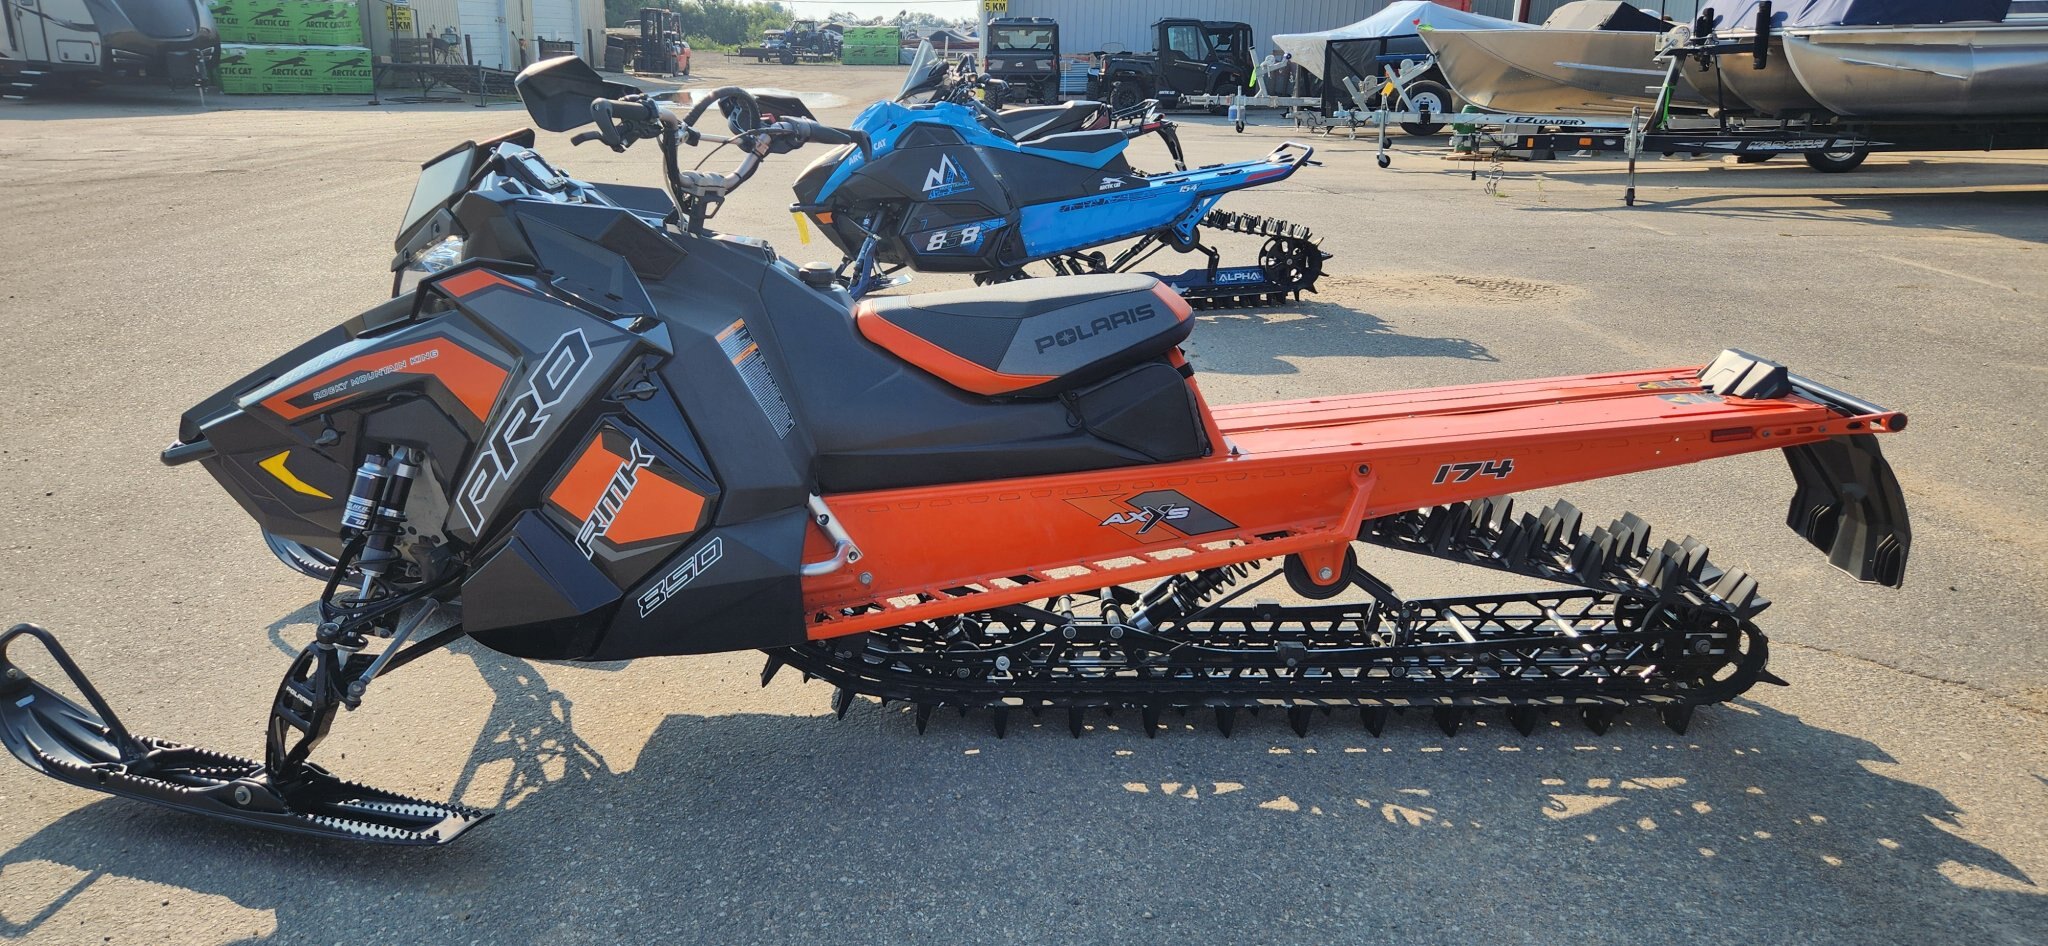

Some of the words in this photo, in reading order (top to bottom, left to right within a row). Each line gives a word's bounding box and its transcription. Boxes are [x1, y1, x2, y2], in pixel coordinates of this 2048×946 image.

[985, 2, 990, 10] 5
[992, 2, 1005, 11] KM
[848, 151, 863, 166] ARC
[873, 138, 887, 151] CAT
[1179, 184, 1197, 193] 154
[926, 226, 981, 252] 858
[1219, 272, 1259, 282] ALPHA
[1034, 303, 1156, 355] POLARIS
[313, 380, 349, 401] ROCKY
[350, 360, 407, 387] MOUNTAIN
[409, 349, 439, 366] KING
[456, 327, 594, 538] PRO
[1432, 458, 1515, 485] 174
[574, 437, 655, 560] RMK
[637, 536, 723, 619] 850
[286, 685, 313, 707] POLARIS
